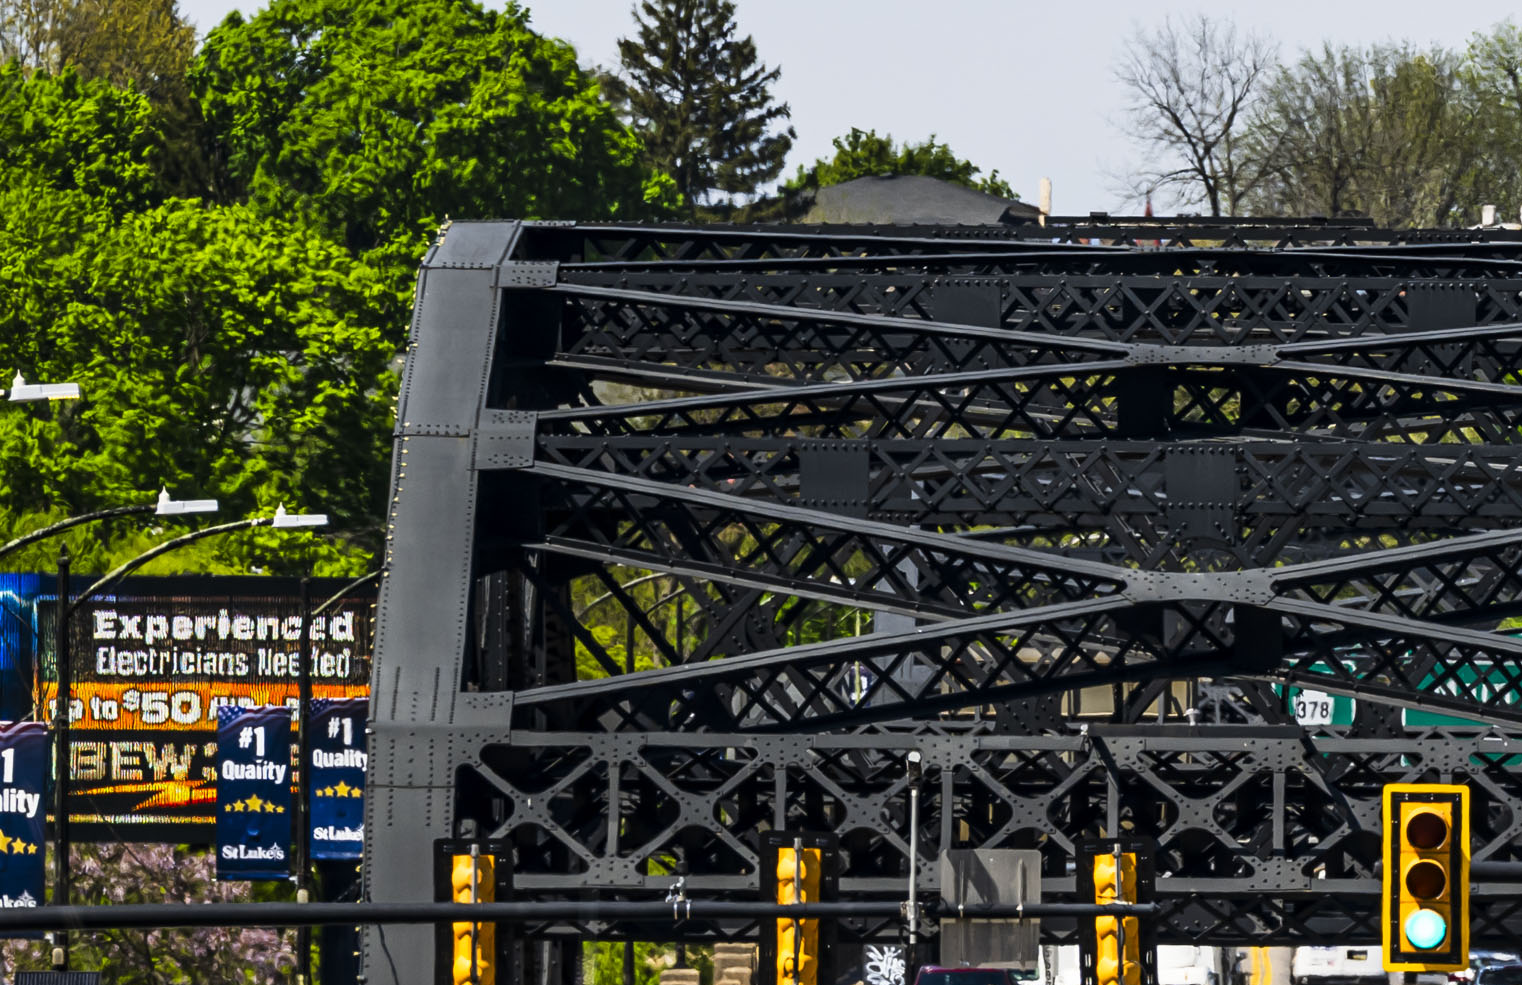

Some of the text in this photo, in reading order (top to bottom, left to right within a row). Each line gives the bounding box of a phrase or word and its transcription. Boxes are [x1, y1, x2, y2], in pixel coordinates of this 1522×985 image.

[92, 608, 354, 645] Experienced
[96, 646, 249, 676] Electricians
[122, 689, 202, 725] $50
[1297, 701, 1329, 719] 378
[239, 726, 266, 757] #1
[328, 716, 353, 745] #1
[222, 760, 287, 785] Quality
[312, 749, 368, 772] Quality
